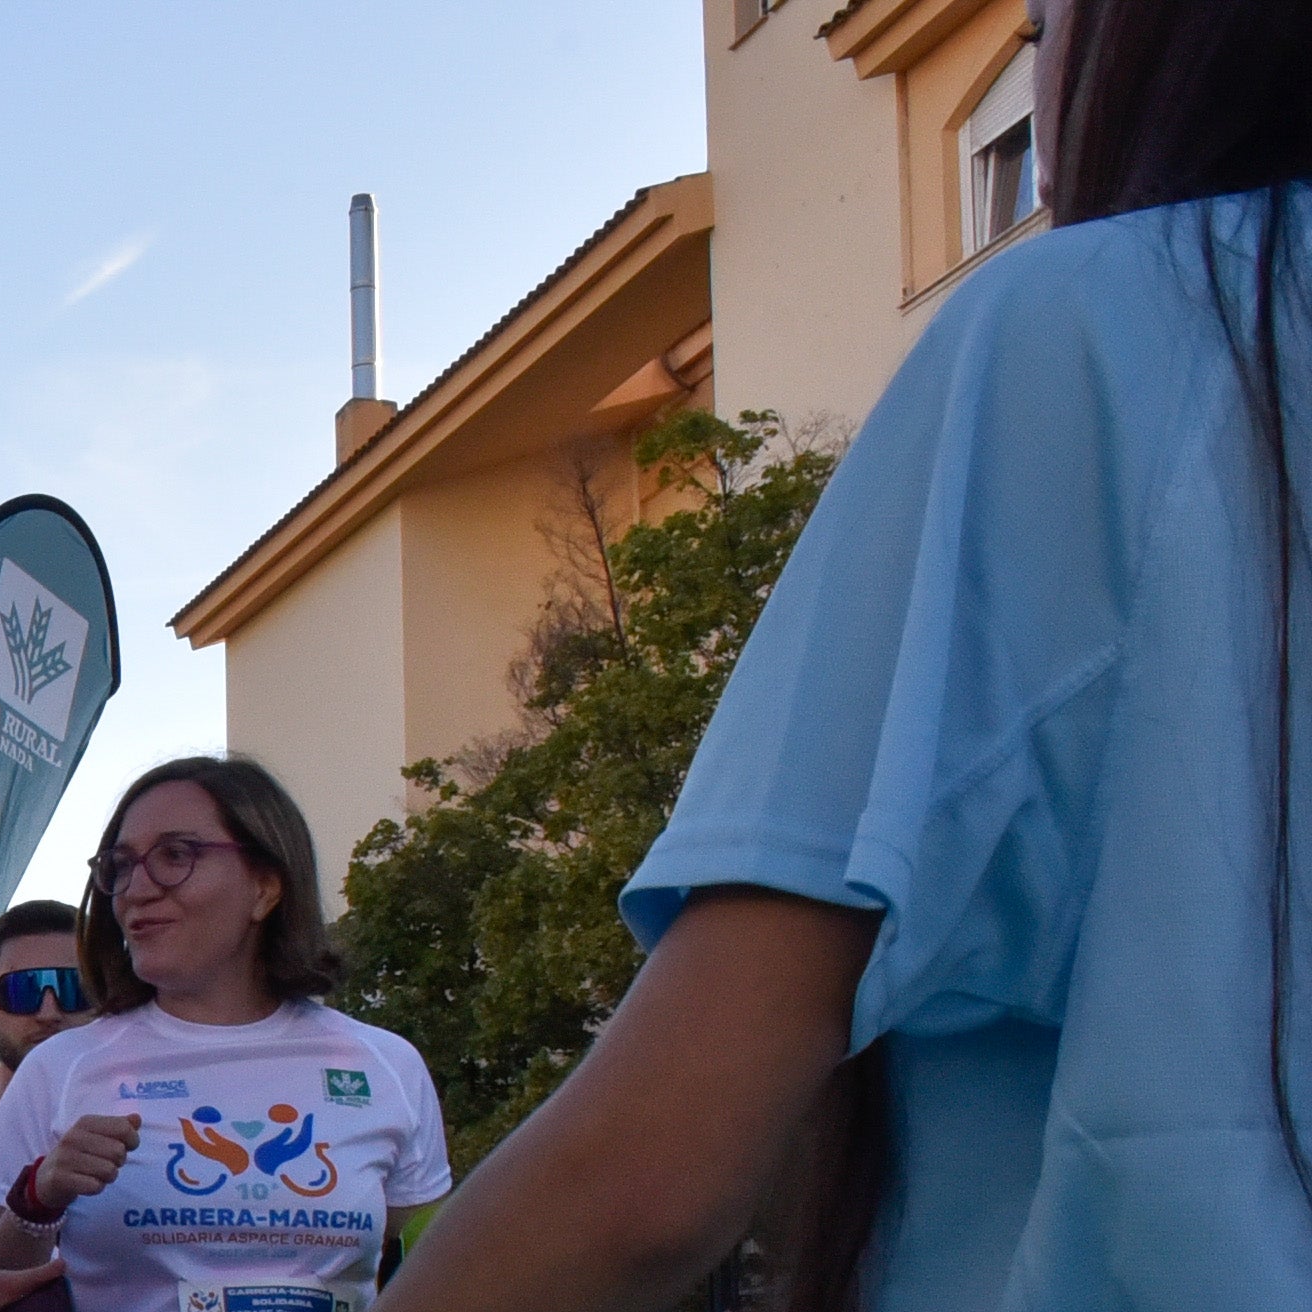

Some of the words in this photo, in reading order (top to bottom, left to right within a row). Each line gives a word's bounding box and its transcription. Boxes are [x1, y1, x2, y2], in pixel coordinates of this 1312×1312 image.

[3, 710, 63, 768] RURAL
[123, 1206, 374, 1232] CARRERA-MARCHA
[141, 1231, 223, 1246] SOLIDARIA
[227, 1231, 290, 1246] ASPACE
[293, 1232, 361, 1248] GRANADA
